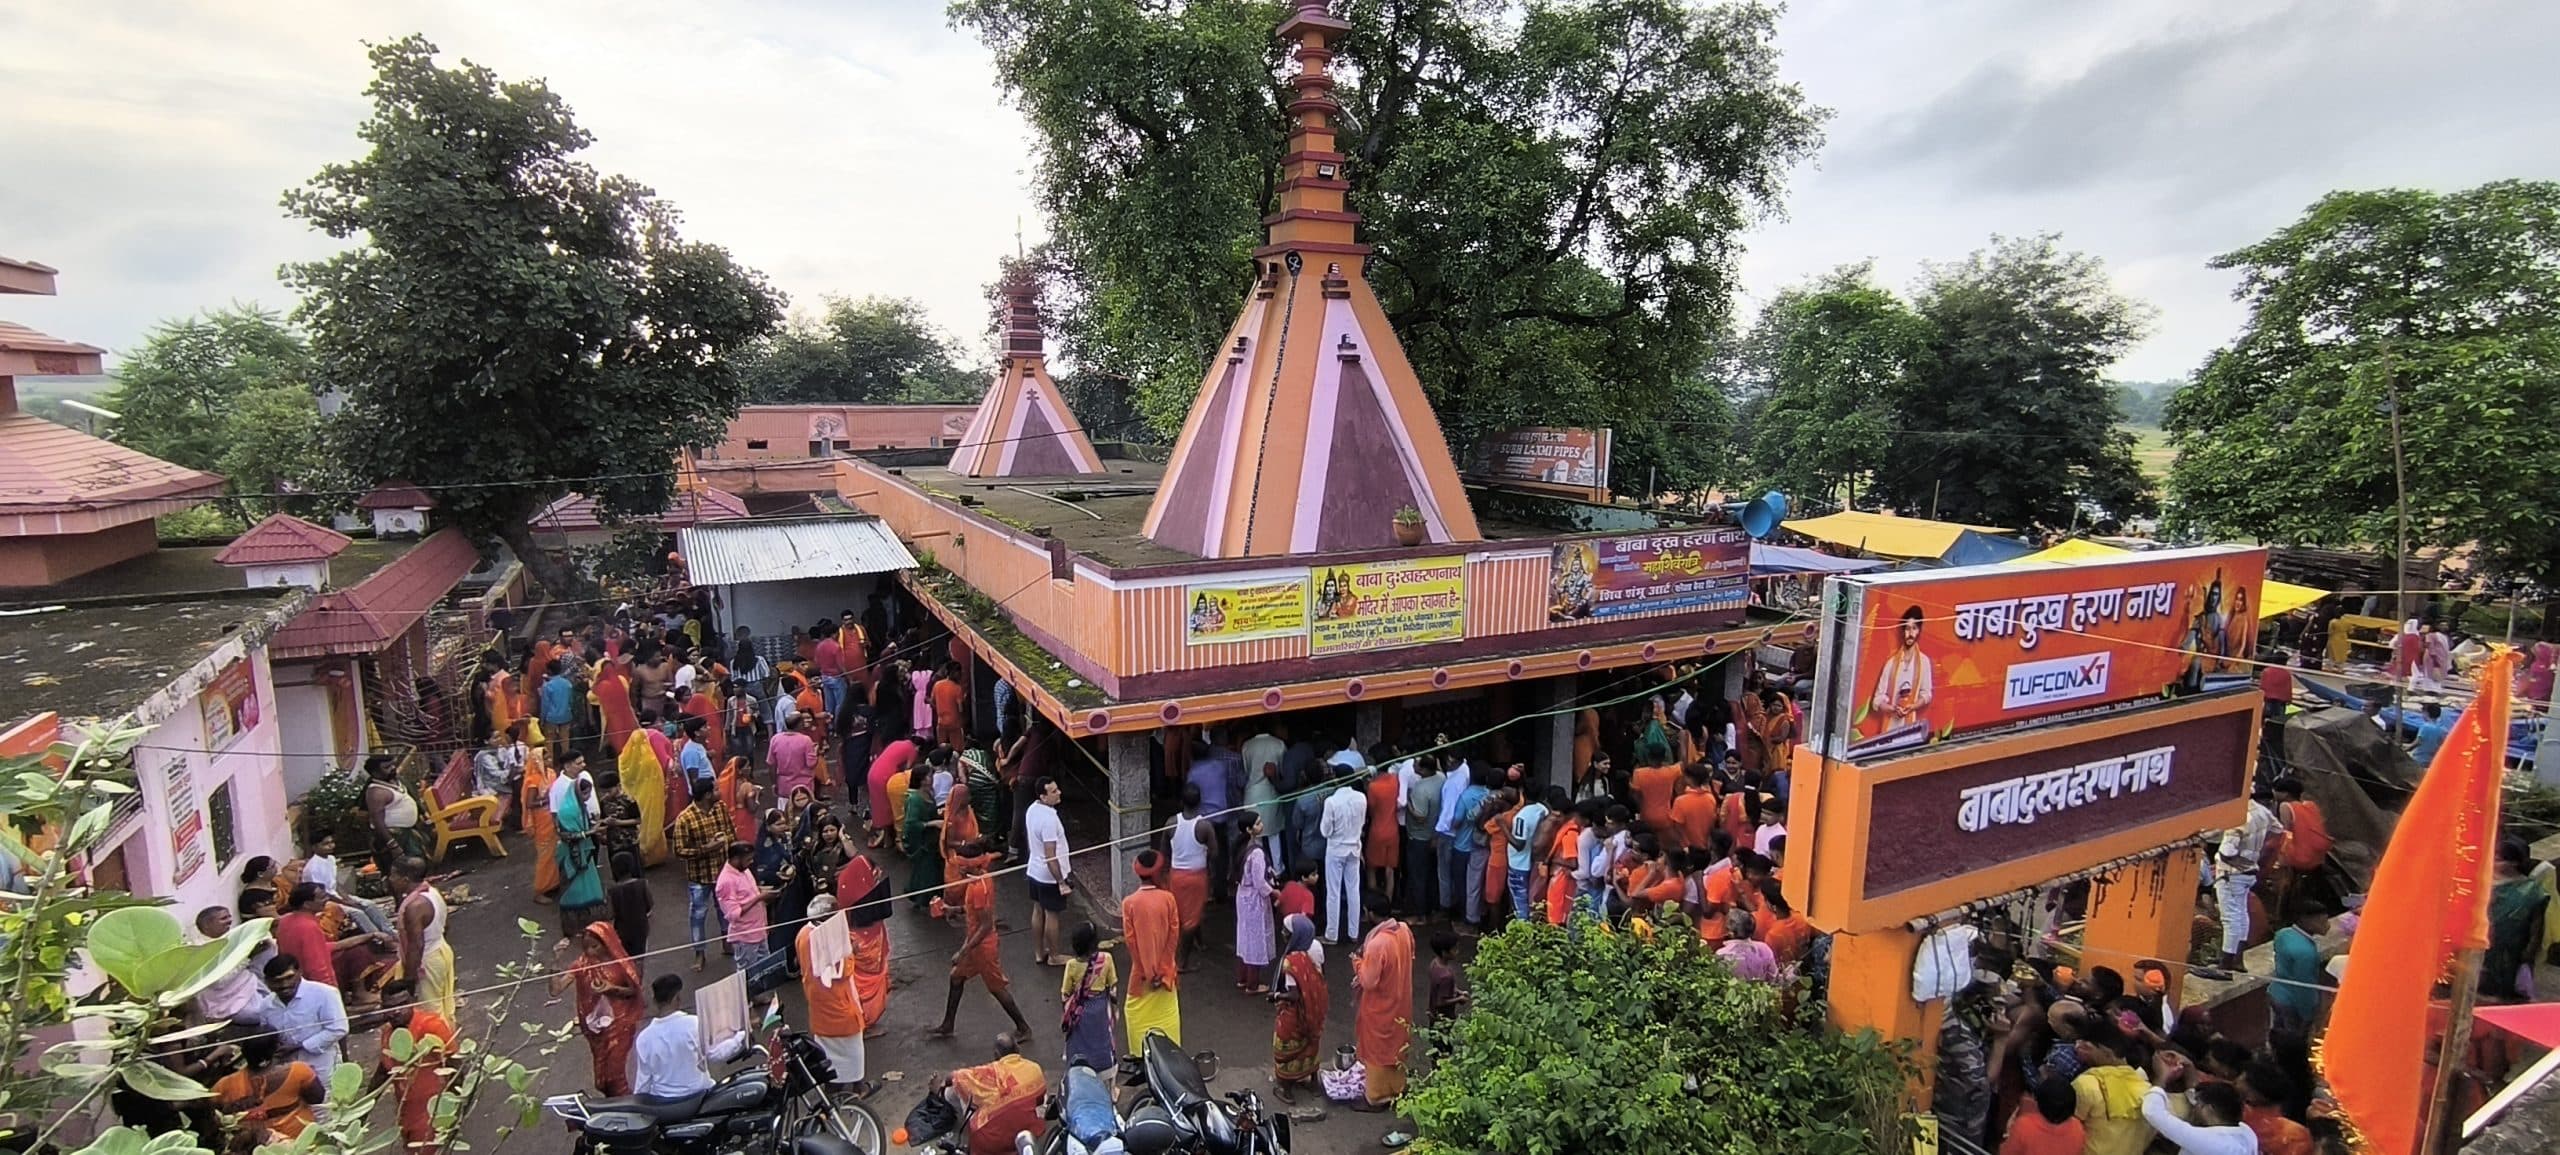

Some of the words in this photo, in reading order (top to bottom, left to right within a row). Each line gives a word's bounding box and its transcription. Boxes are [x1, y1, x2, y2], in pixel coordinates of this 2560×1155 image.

[1555, 446, 1580, 459] PIPES
[1616, 539, 1648, 552] बाबा
[1651, 536, 1678, 555] दुख
[1682, 533, 1717, 548] हरण
[1599, 589, 1623, 601] शिव
[1648, 582, 1671, 595] आर्ट
[1357, 595, 1378, 616] मंदिर
[1381, 592, 1390, 614] में
[1391, 595, 1418, 613] आपका
[1421, 592, 1447, 610] स्वागत
[1954, 599, 2019, 640] बाबा
[2019, 594, 2069, 649] दुख
[2071, 588, 2124, 632] हरण
[2126, 582, 2176, 619] नाथ
